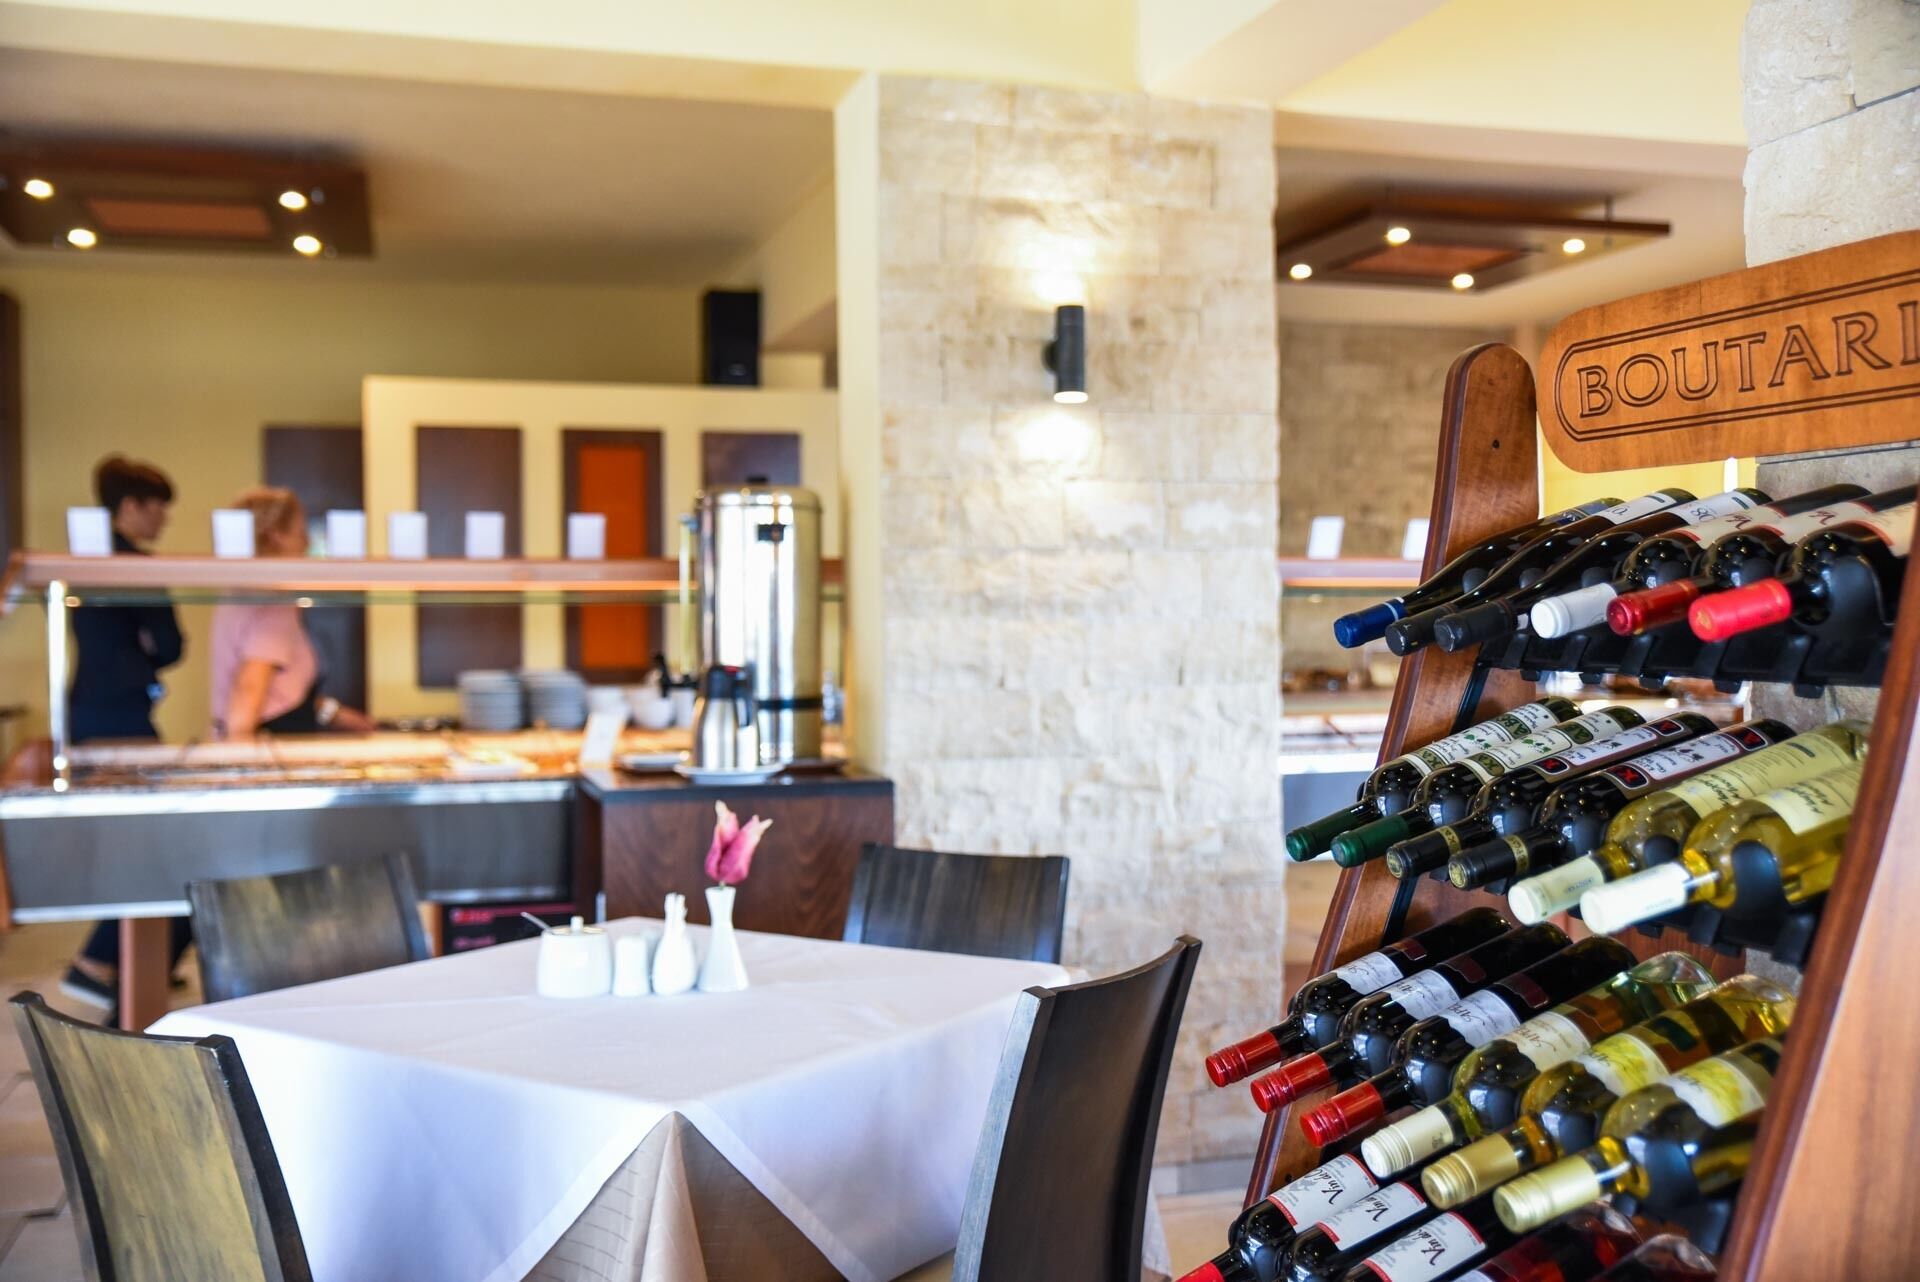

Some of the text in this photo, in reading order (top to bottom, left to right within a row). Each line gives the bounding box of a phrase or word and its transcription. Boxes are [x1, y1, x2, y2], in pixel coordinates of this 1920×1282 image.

[1576, 300, 1920, 419] BOUTARI
[1321, 1180, 1343, 1205] Vin
[1365, 1200, 1389, 1222] Vin
[1420, 1239, 1446, 1265] Vin
